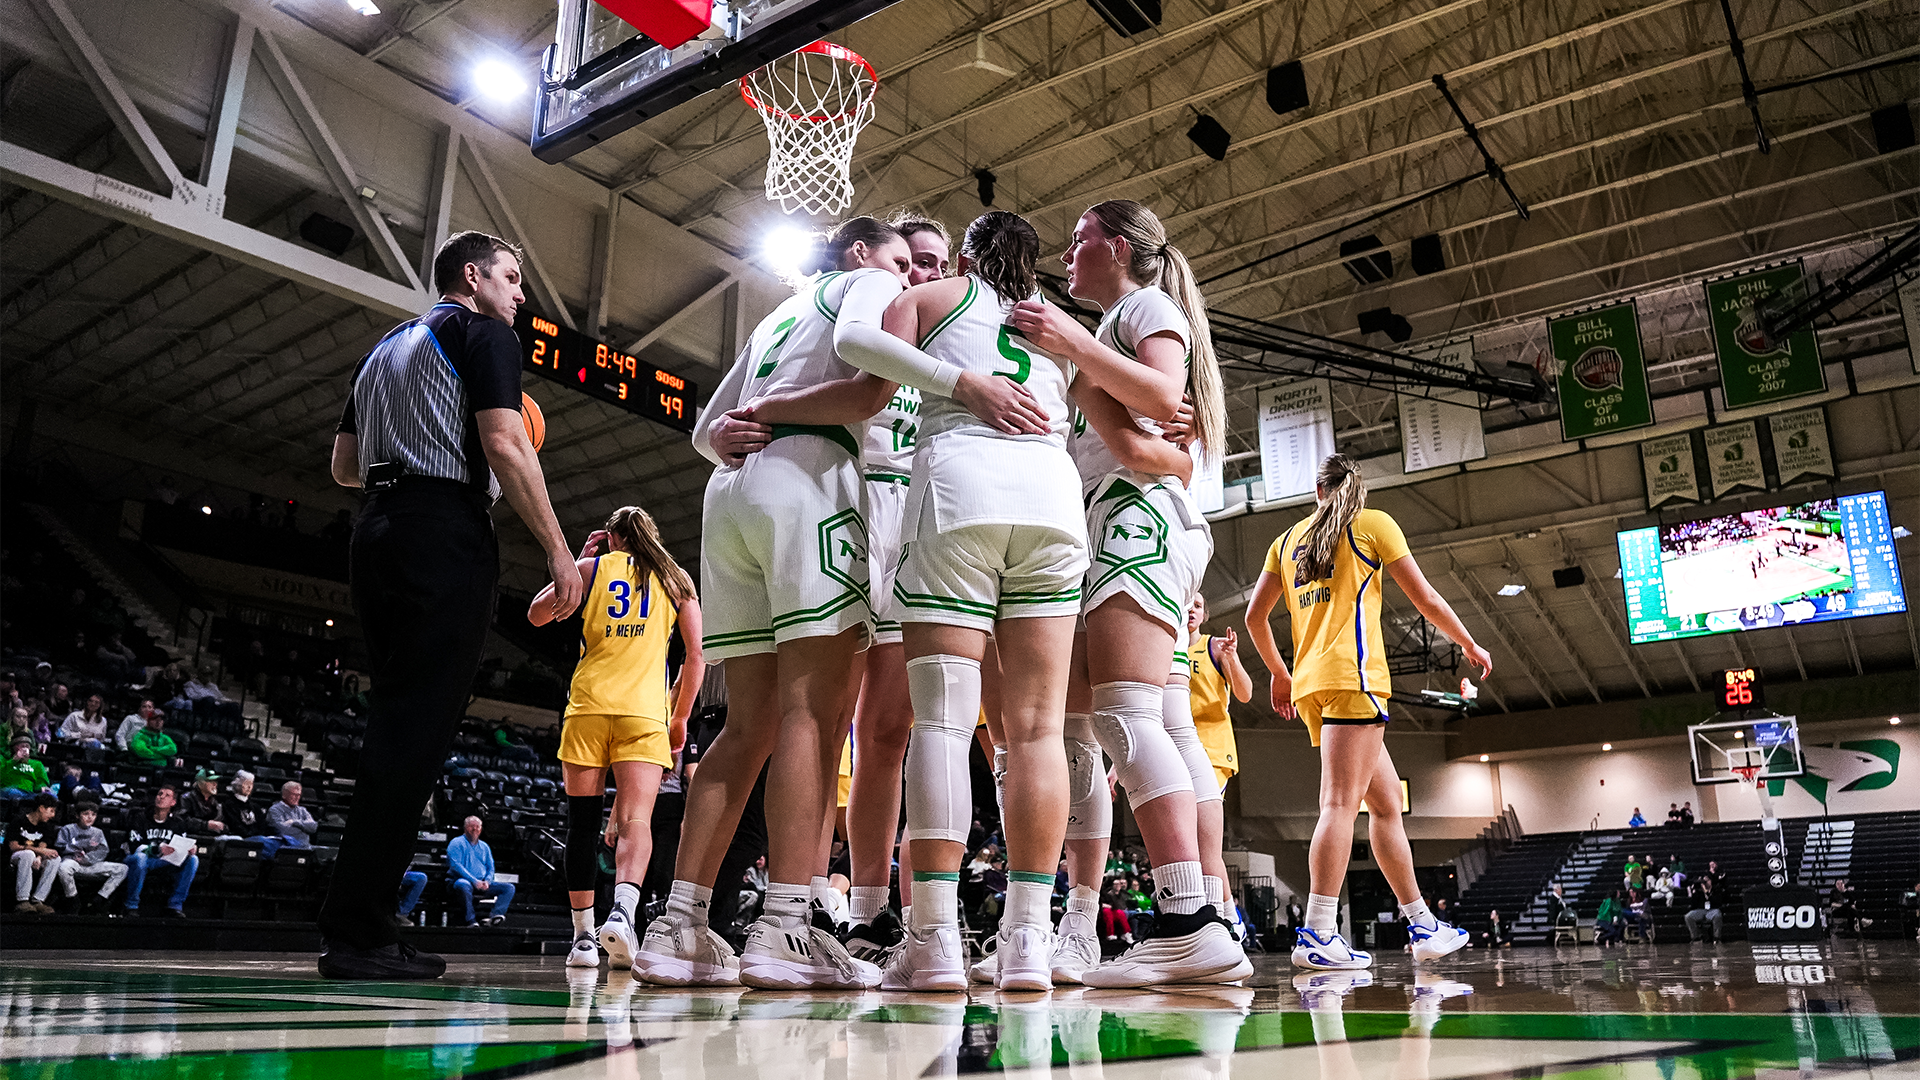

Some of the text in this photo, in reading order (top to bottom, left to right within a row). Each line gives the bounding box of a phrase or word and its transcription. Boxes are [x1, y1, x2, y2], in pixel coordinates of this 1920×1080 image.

[1737, 279, 1772, 295] PHIL
[1577, 318, 1607, 332] BILL
[1573, 327, 1613, 345] FITCH
[532, 339, 560, 370] 21
[755, 316, 797, 378] 2
[992, 323, 1032, 385] 5
[595, 343, 637, 379] 8:49
[1747, 357, 1791, 375] CLASS
[655, 370, 685, 391] SDSU
[1761, 370, 1779, 382] OF
[618, 382, 628, 400] 3
[1273, 385, 1318, 404] NORTH
[1758, 379, 1786, 393] 2007
[660, 393, 684, 419] 49
[1269, 395, 1322, 415] DAKOTA
[1584, 393, 1623, 408] CLASS
[1596, 404, 1612, 416] OF
[1593, 413, 1619, 427] 2019
[260, 576, 324, 601] SIOUX
[1299, 586, 1331, 609] HARTWIG
[607, 579, 650, 619] 31
[1826, 594, 1846, 611] 49
[1745, 603, 1775, 621] 8:49
[616, 624, 645, 638] MEYER
[1680, 614, 1699, 630] 21
[1726, 669, 1754, 685] 8:49
[1725, 682, 1753, 705] 26
[1748, 905, 1815, 929] WILD GO
[1748, 920, 1775, 929] WINGS
